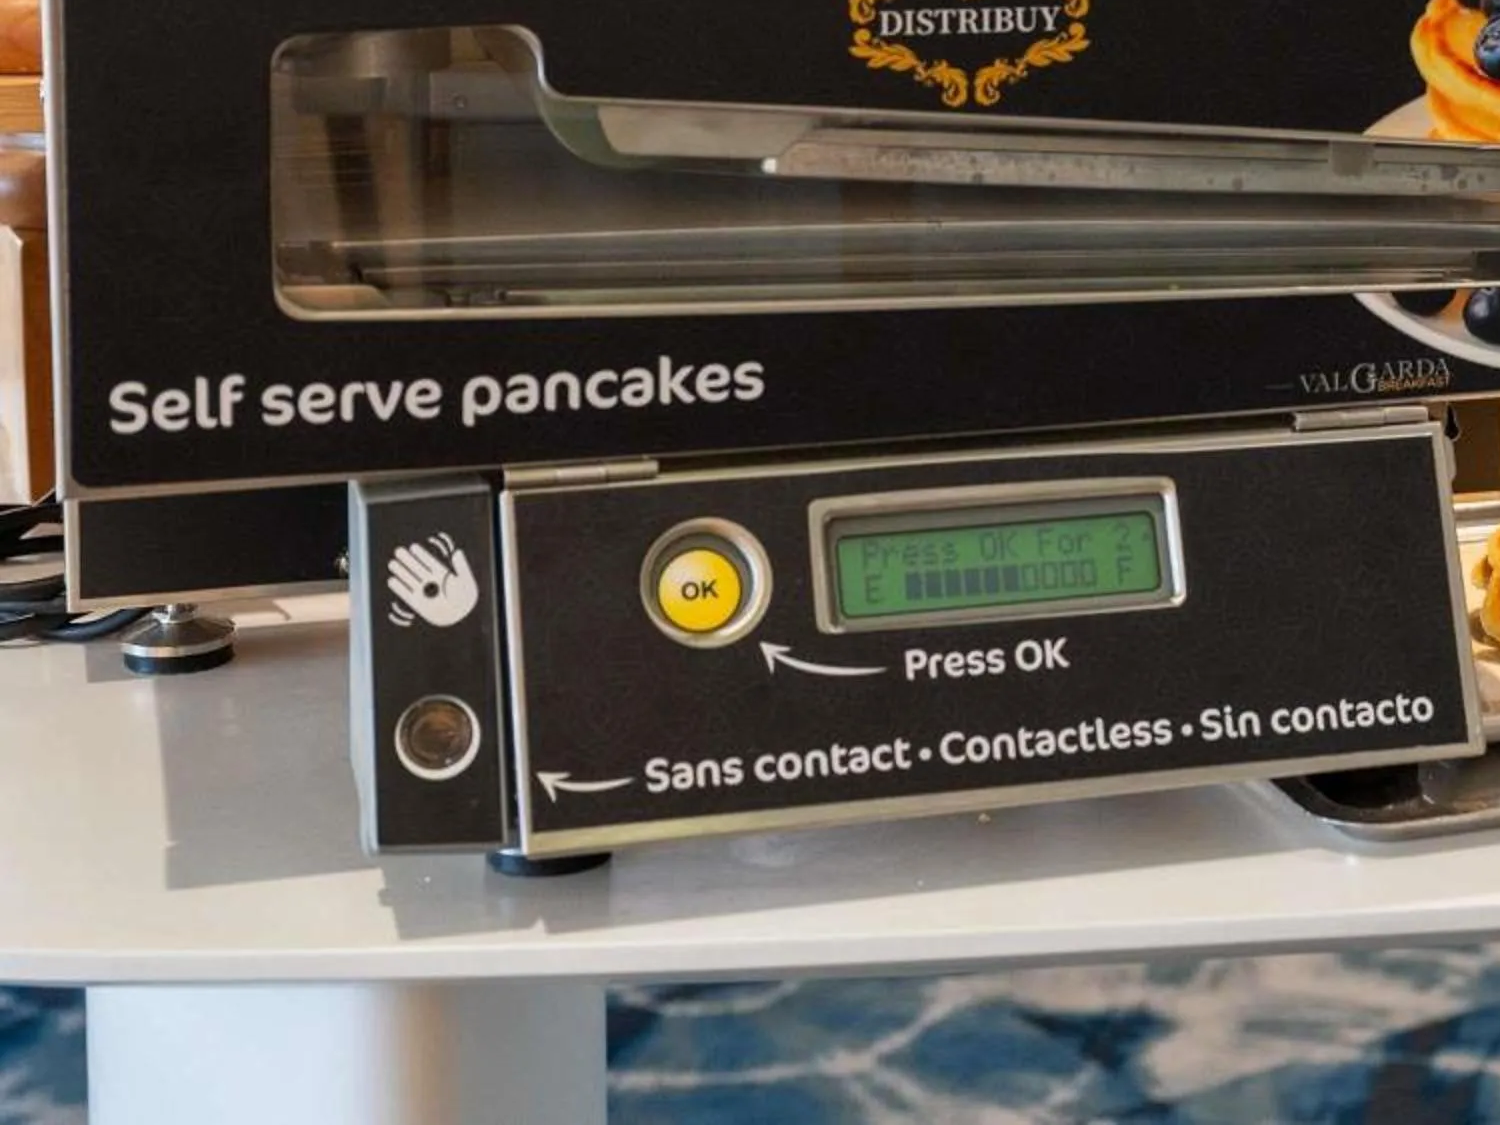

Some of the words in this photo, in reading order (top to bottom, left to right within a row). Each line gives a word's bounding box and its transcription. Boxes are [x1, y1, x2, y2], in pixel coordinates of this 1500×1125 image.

[879, 6, 1061, 37] DISTRIBUY
[109, 373, 246, 435] Self
[261, 378, 443, 426] serve
[462, 355, 765, 427] pancakes
[1376, 376, 1450, 393] BREAKFAST
[861, 539, 960, 570] Press
[980, 530, 1019, 562] OK
[1037, 526, 1093, 556] For
[681, 579, 720, 602] OK
[904, 648, 1006, 681] Press
[1014, 637, 1070, 672] OK
[644, 757, 744, 793] Sans
[753, 737, 912, 782] contact
[939, 717, 1173, 765] Contactless
[1199, 705, 1261, 741] Sin
[1270, 693, 1434, 735] contacto
